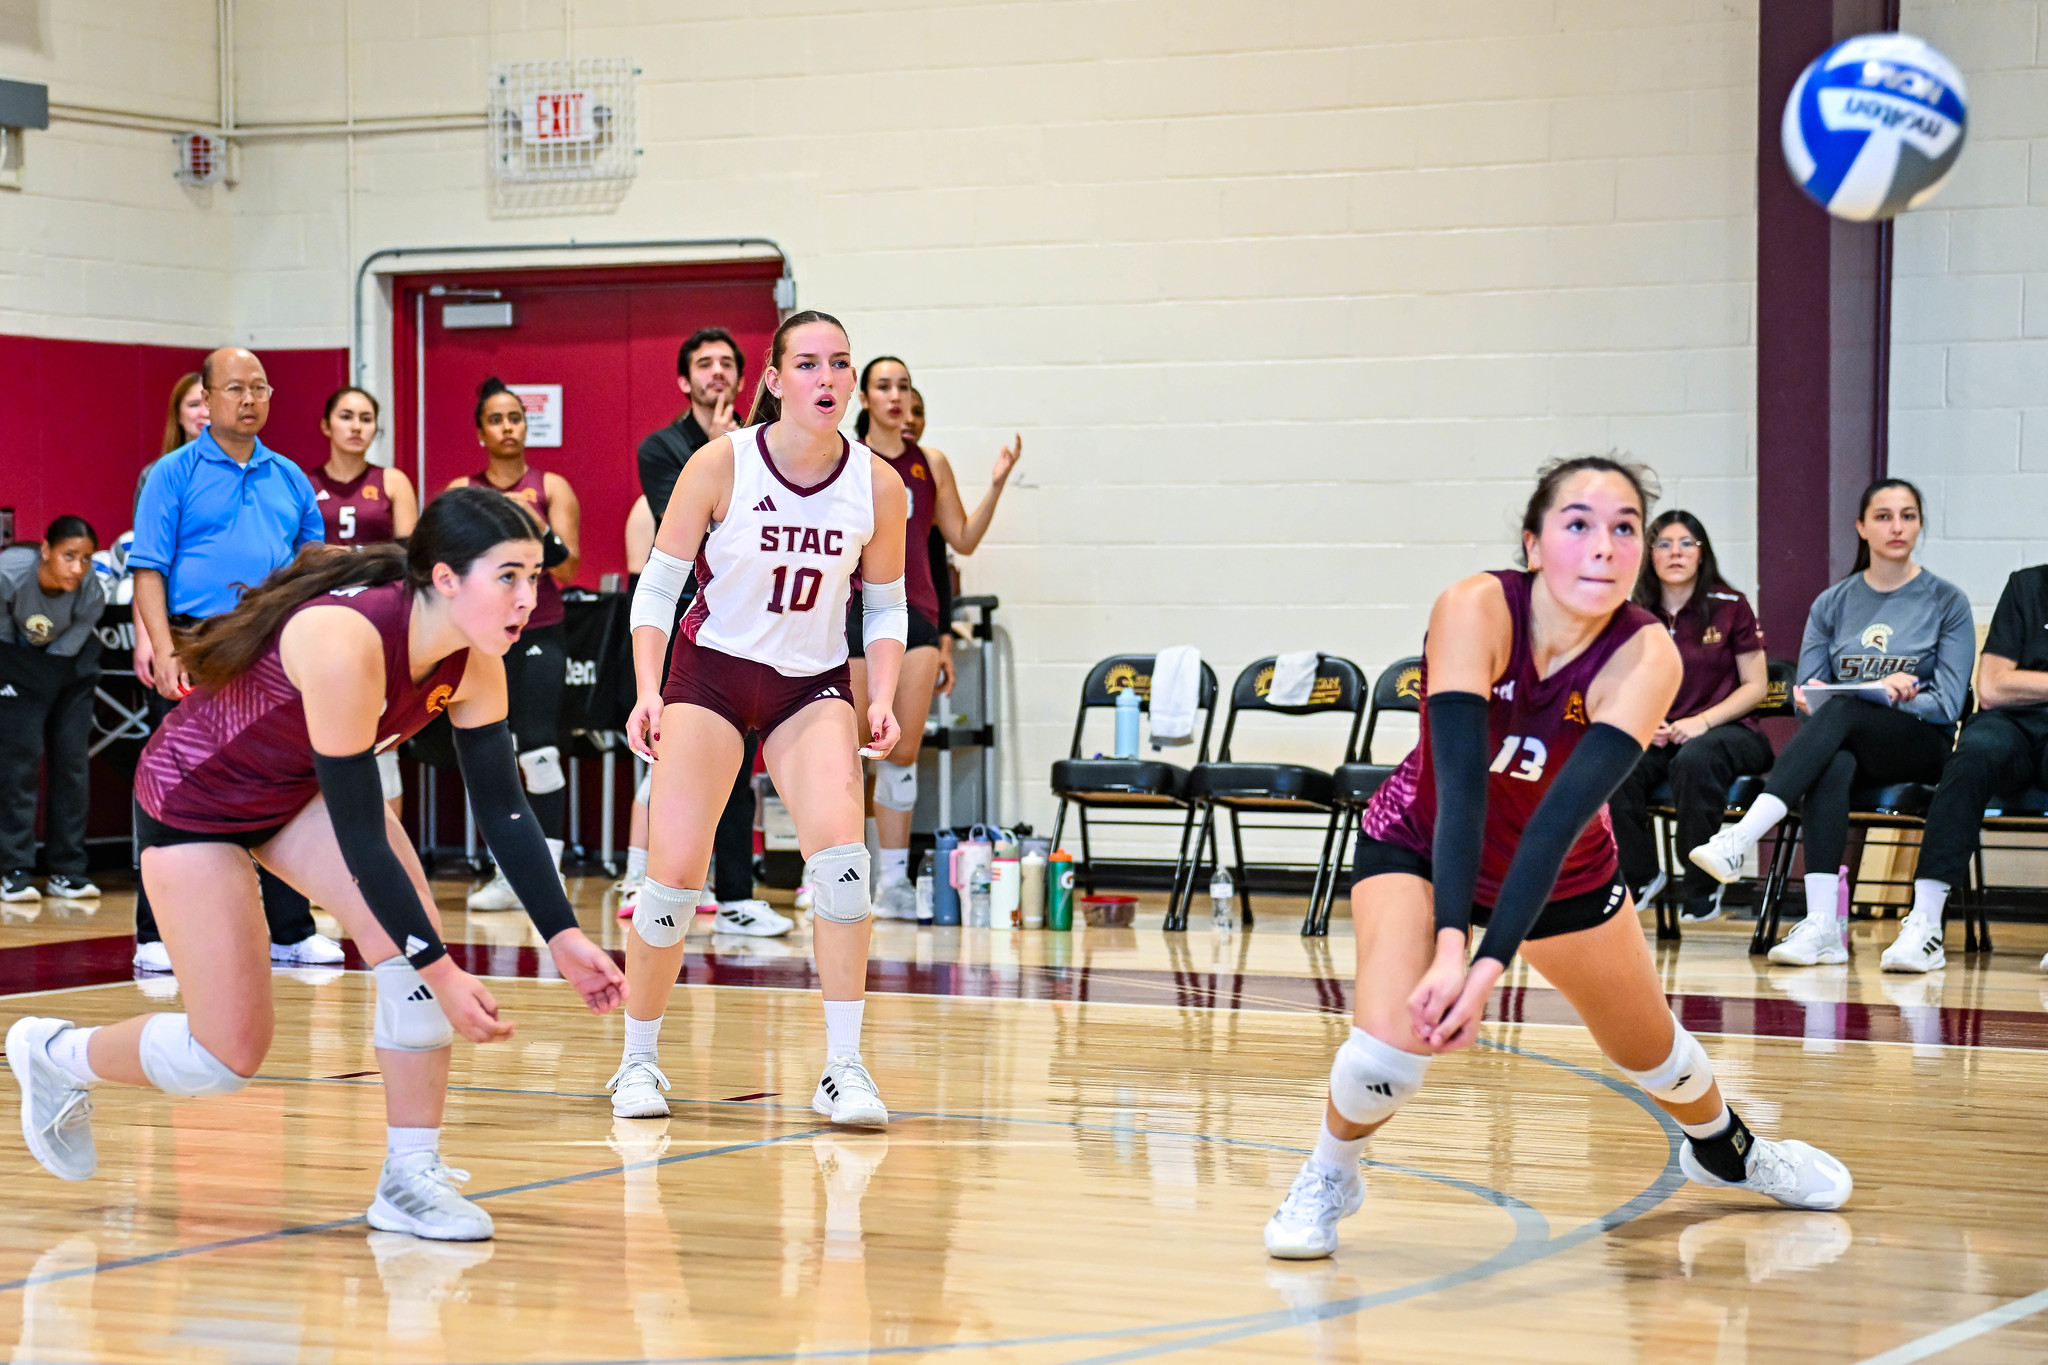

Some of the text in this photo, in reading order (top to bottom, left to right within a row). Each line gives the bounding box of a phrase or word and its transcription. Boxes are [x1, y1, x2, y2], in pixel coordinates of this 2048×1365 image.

[536, 93, 584, 139] EXIT
[1844, 97, 1943, 139] molten
[338, 505, 356, 539] 5
[760, 525, 843, 556] STAC
[766, 565, 824, 615] 10
[99, 622, 136, 650] oll
[1838, 654, 1920, 680] STAC
[1488, 735, 1548, 782] 13
